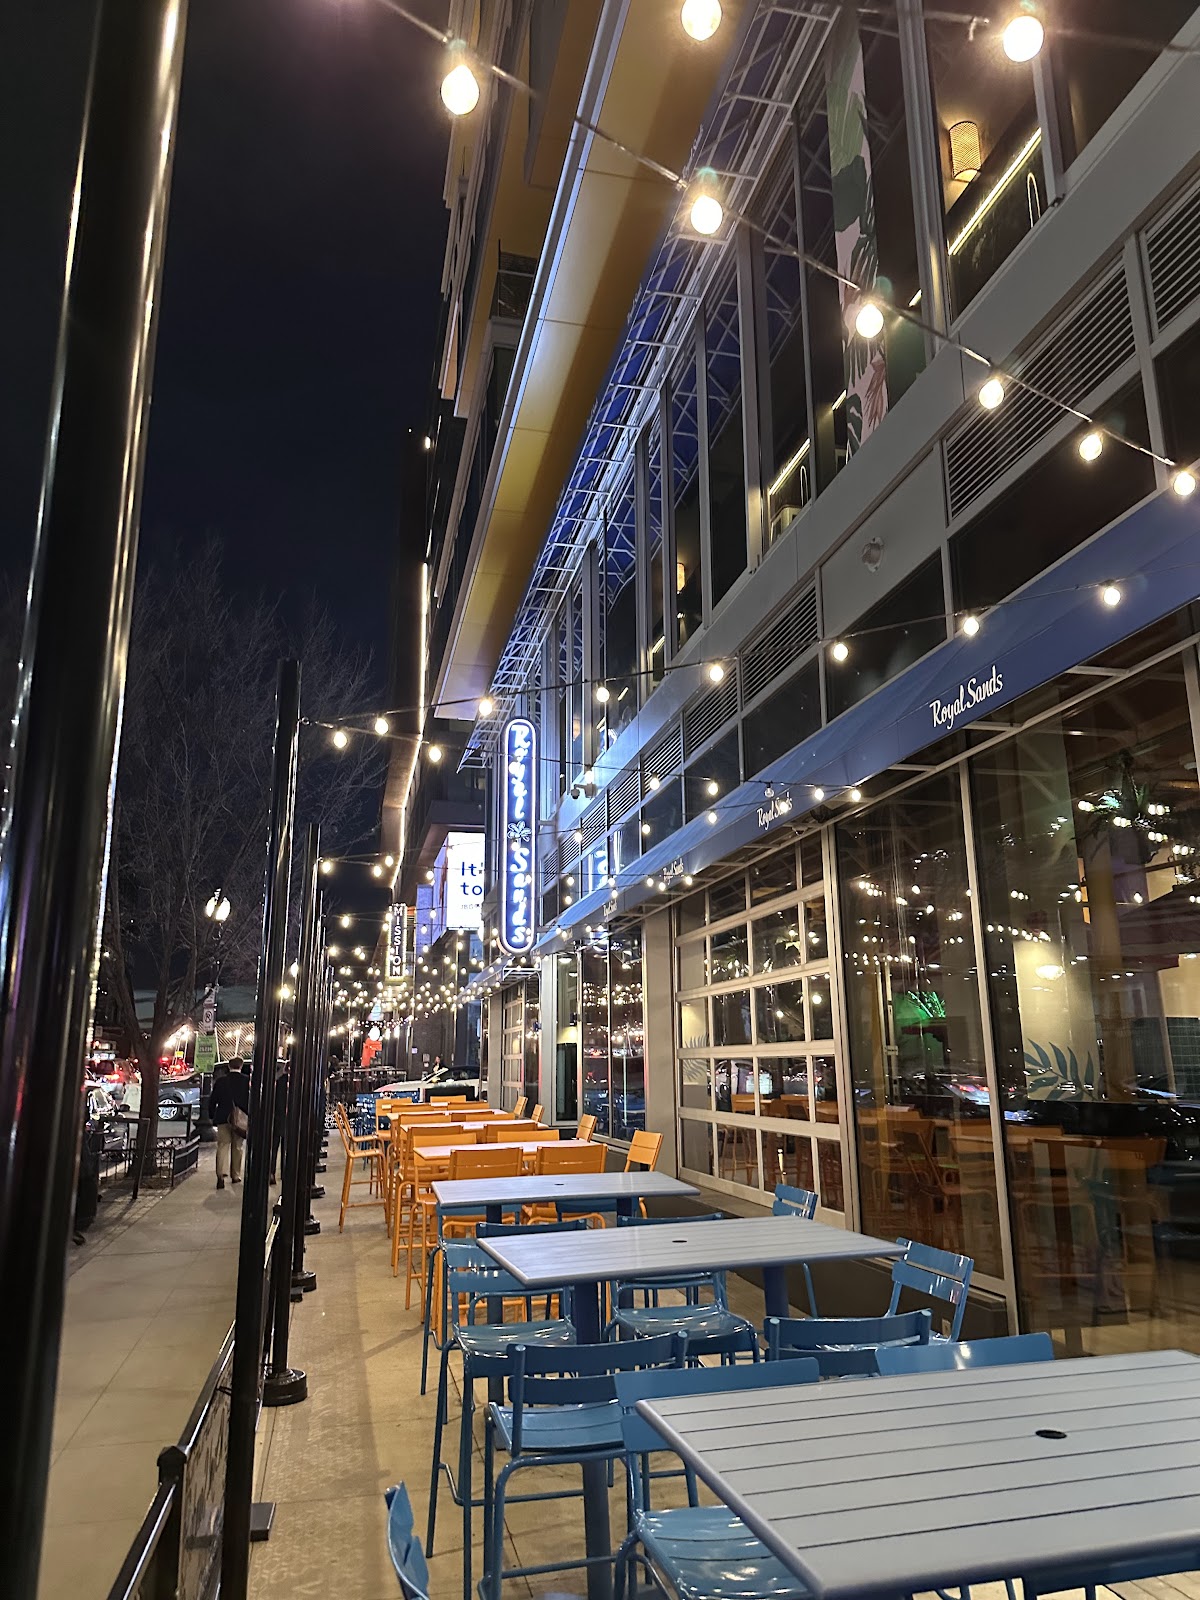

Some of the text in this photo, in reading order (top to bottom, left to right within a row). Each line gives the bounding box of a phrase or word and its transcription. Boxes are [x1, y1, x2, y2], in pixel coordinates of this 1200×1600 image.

[928, 664, 1004, 731] Royal Sands
[508, 723, 532, 943] Royal Sands
[756, 800, 774, 831] Royal
[391, 906, 404, 977] MISSION
